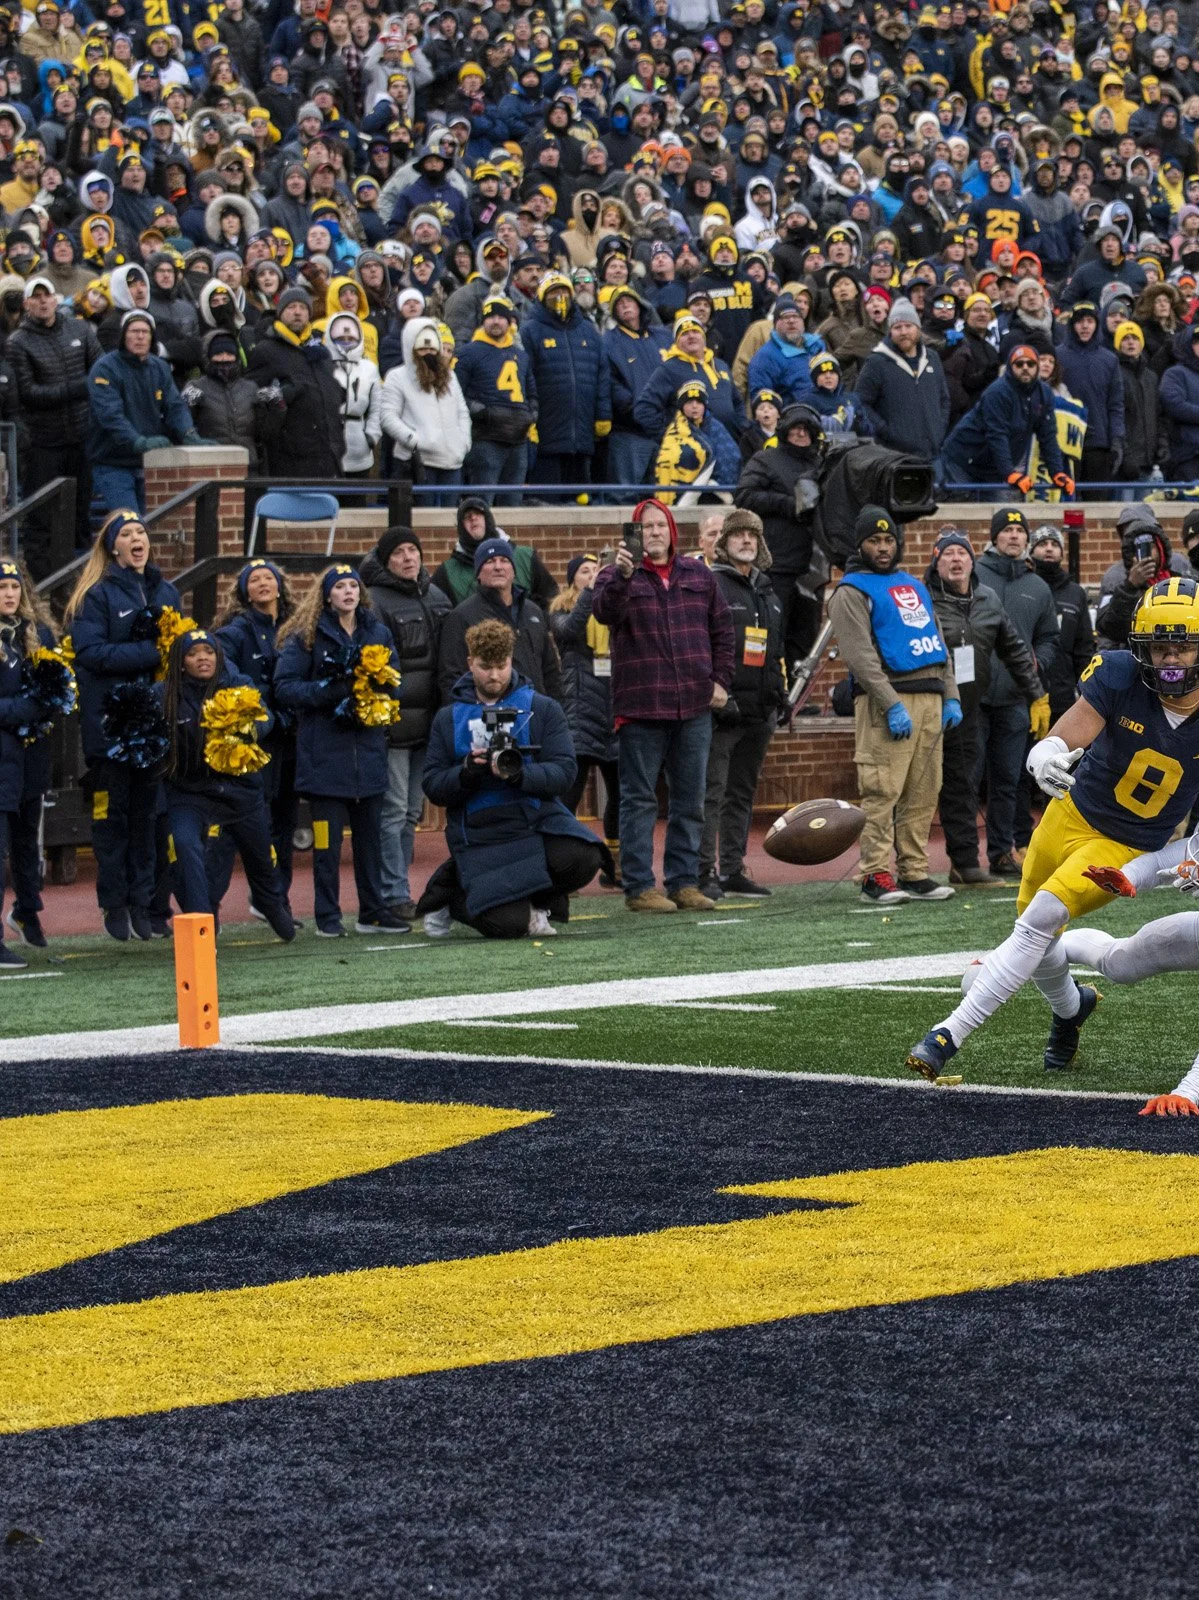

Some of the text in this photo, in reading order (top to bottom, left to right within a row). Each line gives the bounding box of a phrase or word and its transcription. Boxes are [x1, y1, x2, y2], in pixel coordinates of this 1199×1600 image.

[143, 0, 171, 27] 21
[985, 208, 1020, 241] 25
[727, 295, 753, 310] BLUE
[496, 360, 524, 402] 4
[1007, 512, 1022, 522] M
[2, 564, 18, 576] M
[335, 564, 352, 575] M
[189, 630, 207, 641] M
[1081, 655, 1103, 682] 8
[1114, 748, 1184, 819] 8
